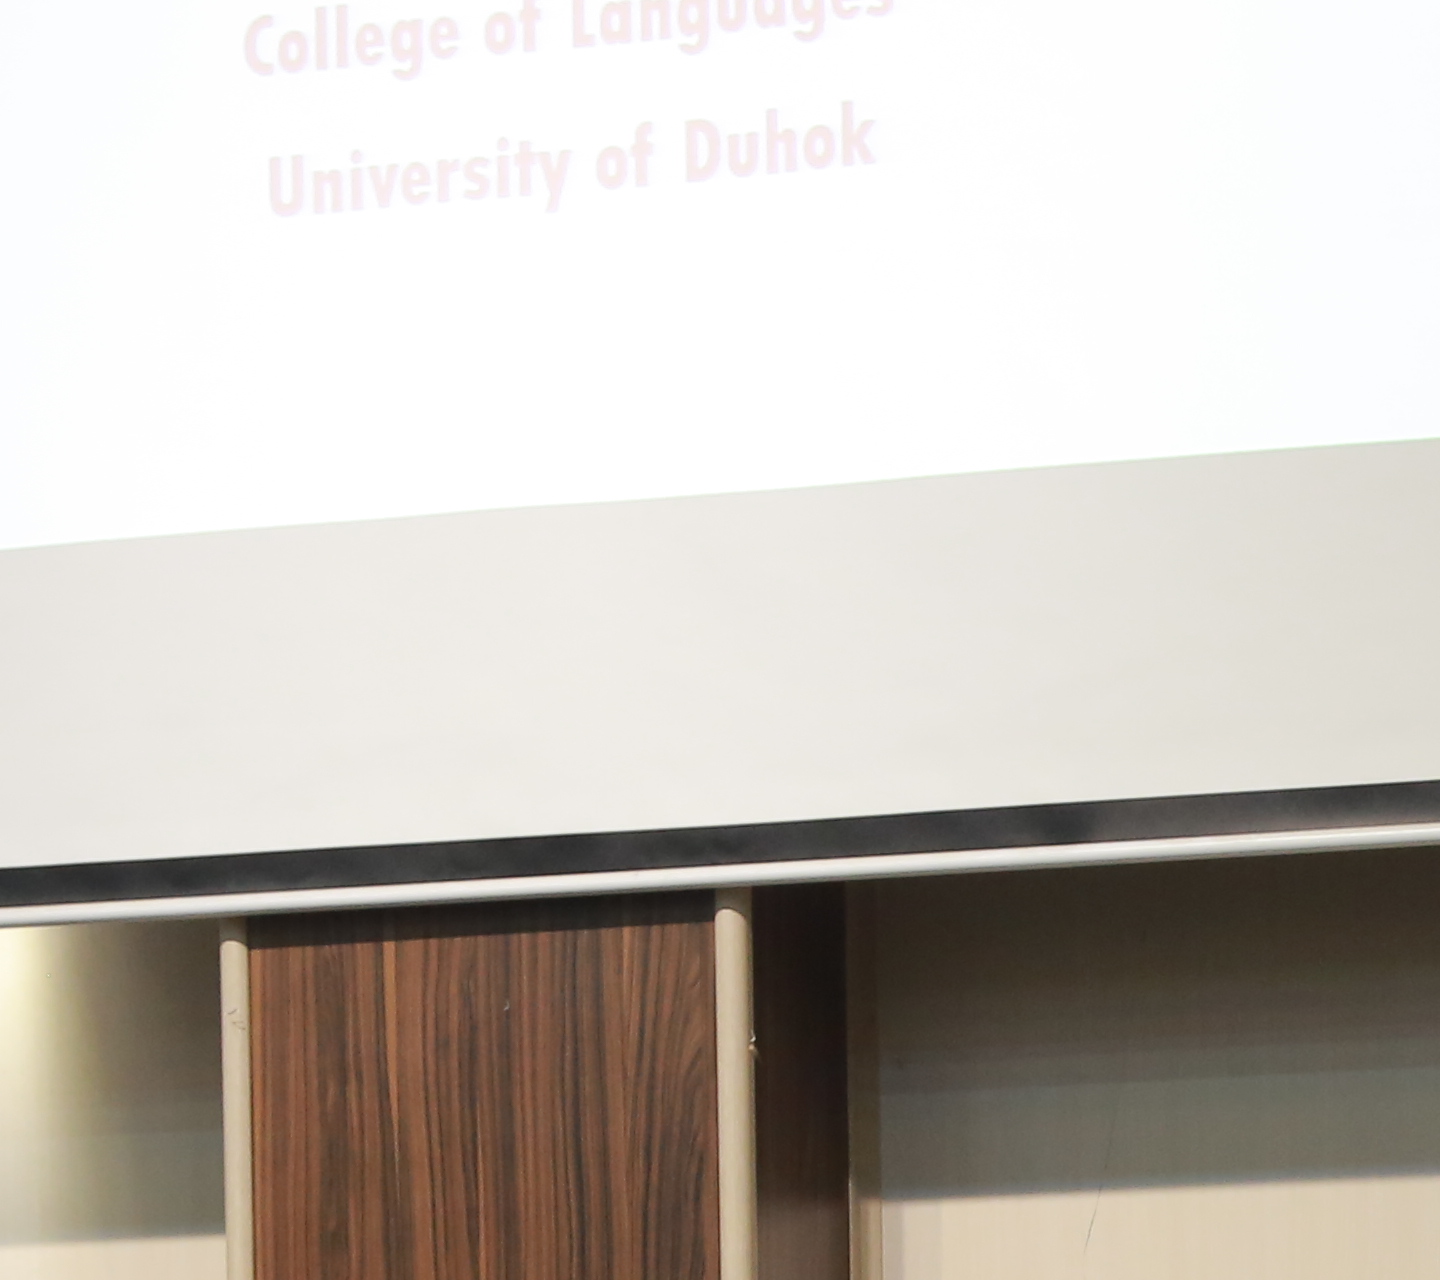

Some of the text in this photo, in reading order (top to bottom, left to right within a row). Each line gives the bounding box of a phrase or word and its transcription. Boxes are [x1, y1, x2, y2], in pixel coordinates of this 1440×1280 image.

[243, 2, 461, 81] College
[483, 0, 541, 55] of
[267, 99, 877, 218] University of Duhok
